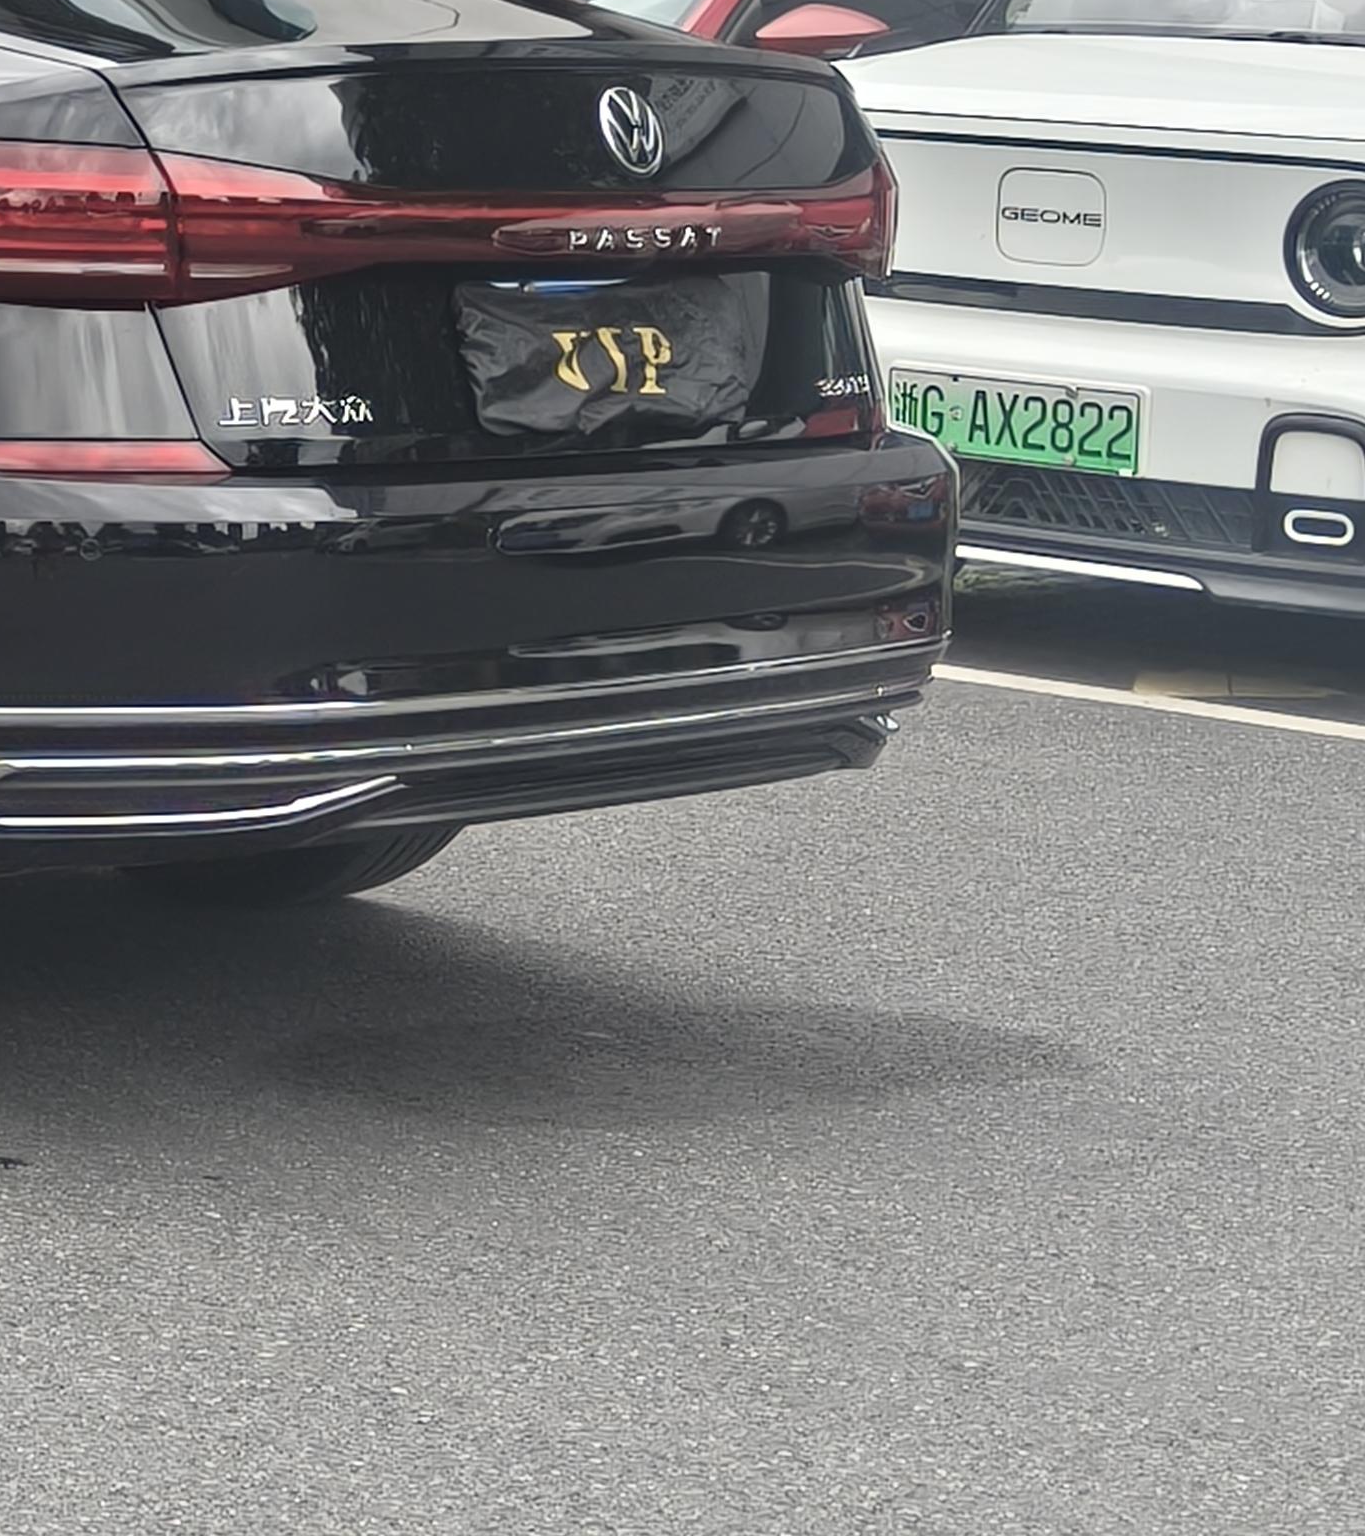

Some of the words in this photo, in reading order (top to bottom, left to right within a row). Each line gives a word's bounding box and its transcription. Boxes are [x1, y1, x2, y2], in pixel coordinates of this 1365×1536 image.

[1002, 206, 1102, 228] GEOME
[569, 226, 722, 251] PASSAT
[551, 326, 672, 394] VIP
